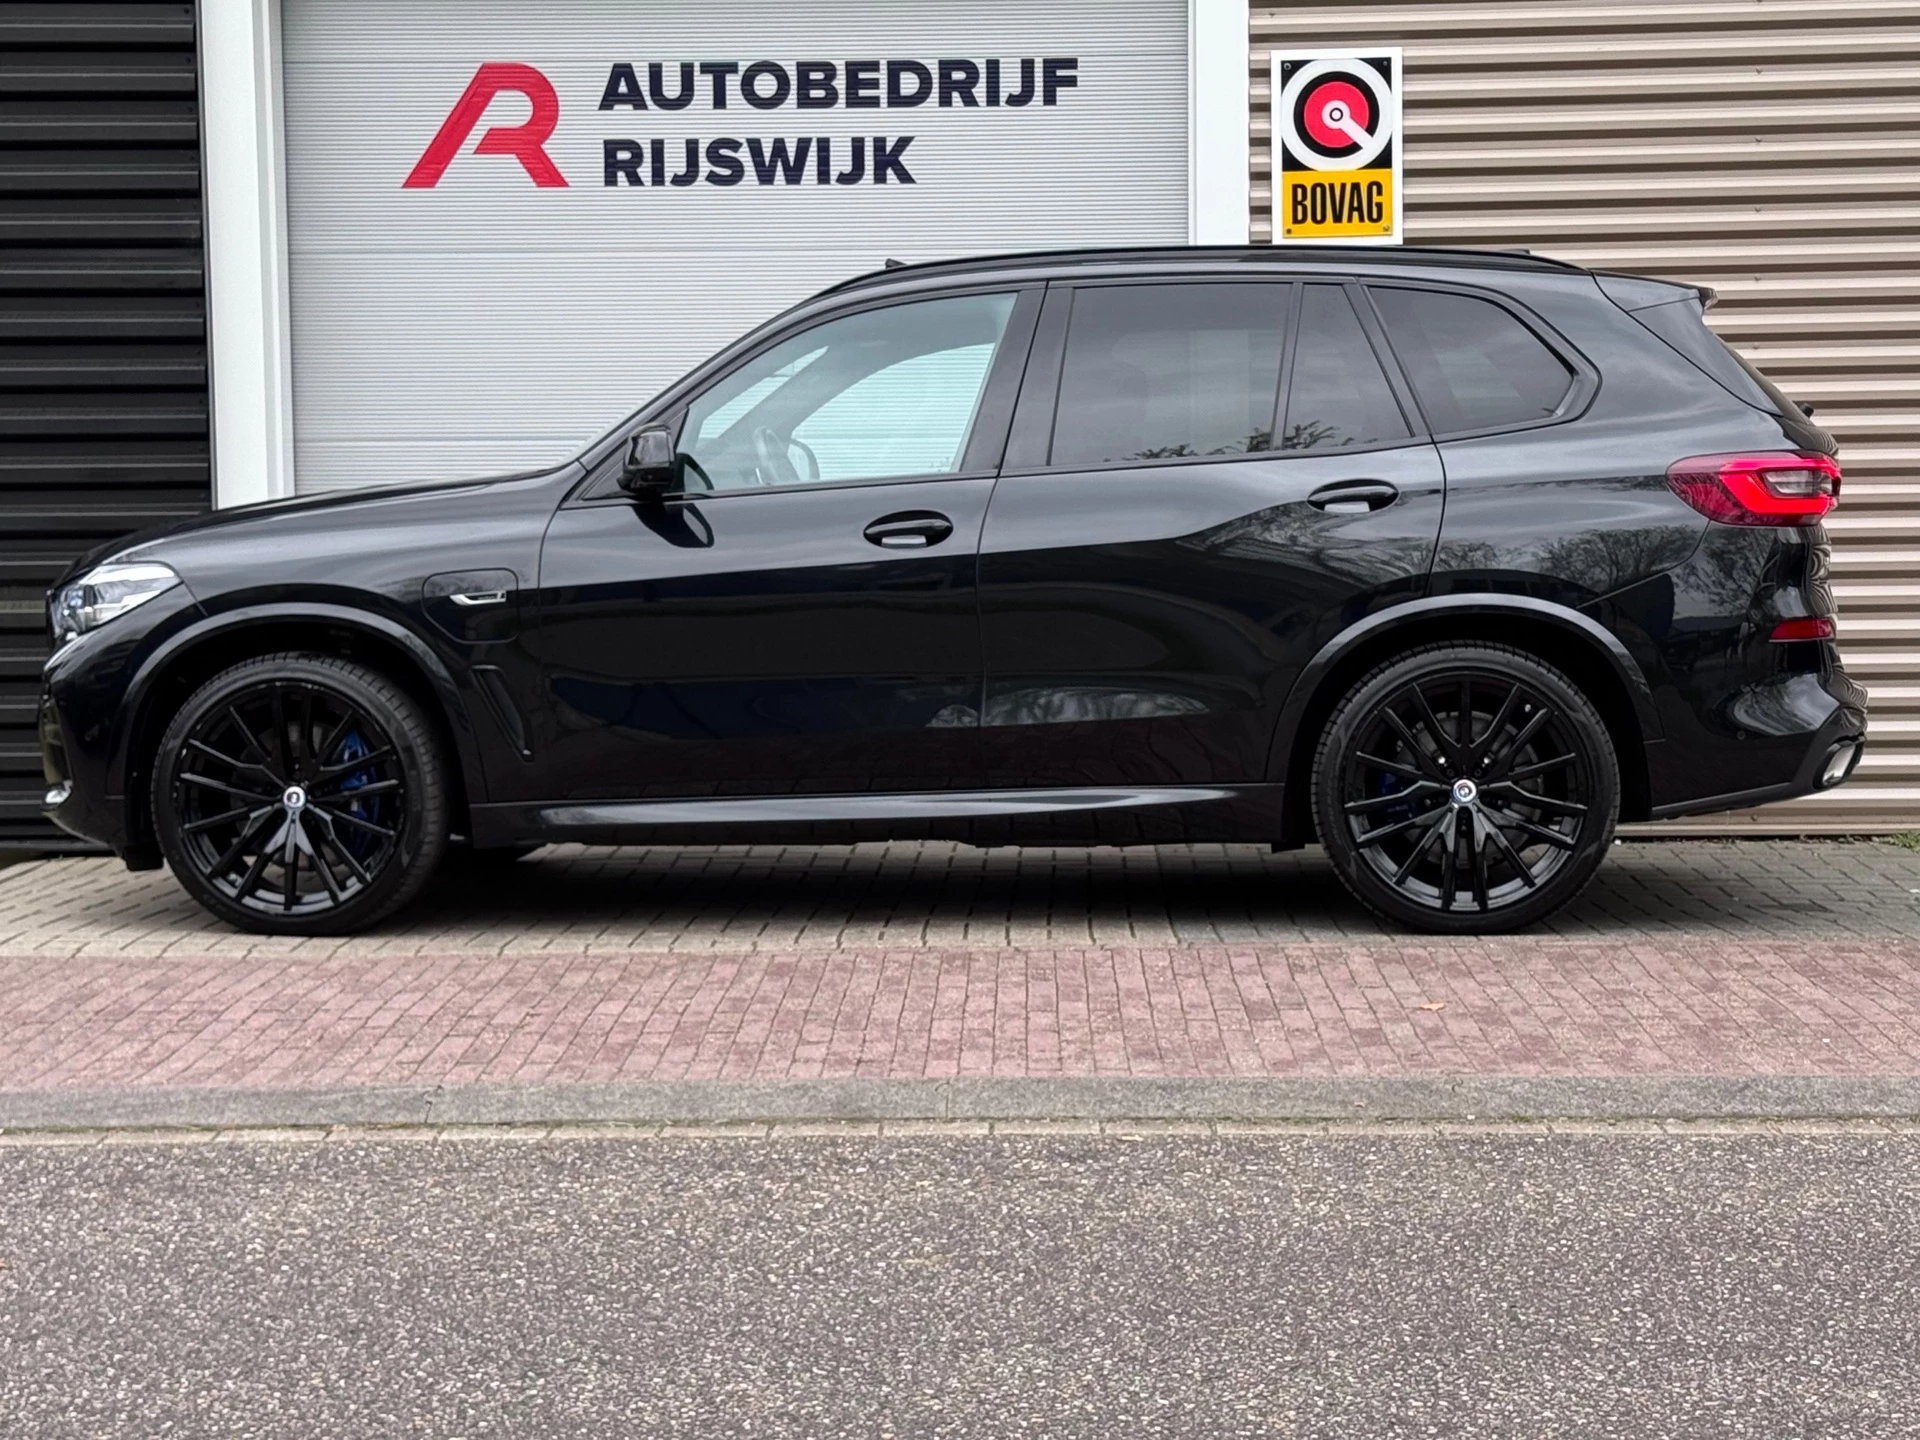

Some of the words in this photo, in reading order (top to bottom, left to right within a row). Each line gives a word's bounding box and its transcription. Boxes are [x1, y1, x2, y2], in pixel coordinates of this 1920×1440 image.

[599, 58, 1078, 110] AUTOBEDRIJF
[604, 137, 915, 186] RIJSWIJK
[1293, 182, 1382, 224] BOVAG
